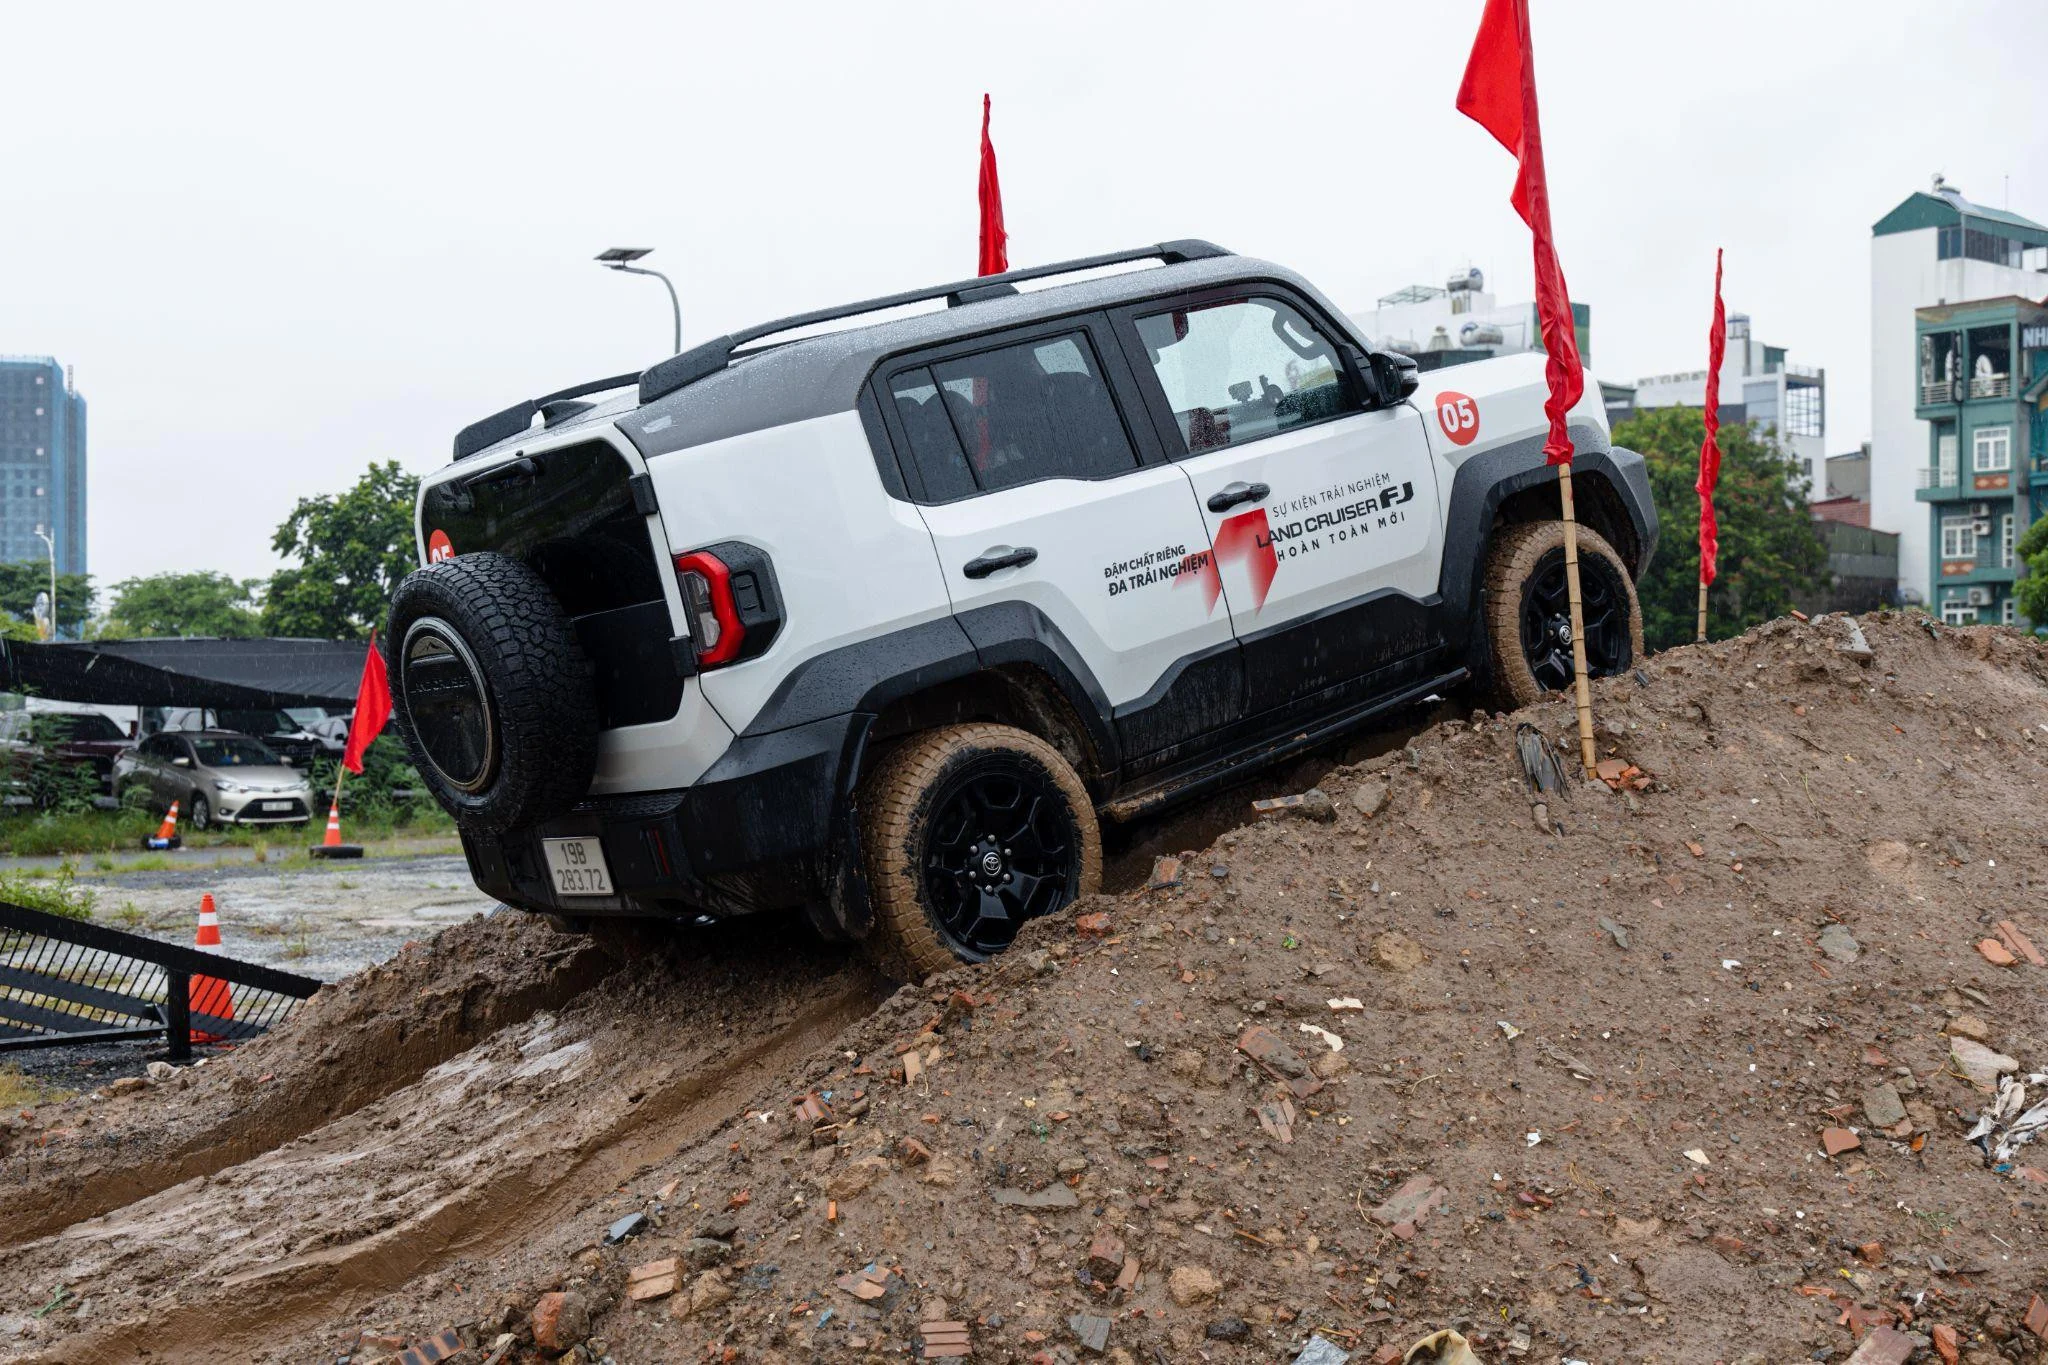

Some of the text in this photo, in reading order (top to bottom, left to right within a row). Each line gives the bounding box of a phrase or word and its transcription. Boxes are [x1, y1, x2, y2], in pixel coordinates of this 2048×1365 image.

[2023, 327, 2048, 347] NH
[1442, 398, 1474, 433] 05
[1272, 502, 1287, 518] SỰ
[1347, 472, 1391, 495] NGHIỆM
[1256, 481, 1414, 548] LAND CRUISER FJ
[1277, 510, 1405, 561] HOÀN TOÀN MỚI
[1104, 544, 1186, 579] ĐẬM CHẤT RIÊNG
[1108, 553, 1209, 597] ĐA TRẢI NGHIỆM
[561, 842, 587, 865] 19B
[556, 868, 606, 891] 283.72
